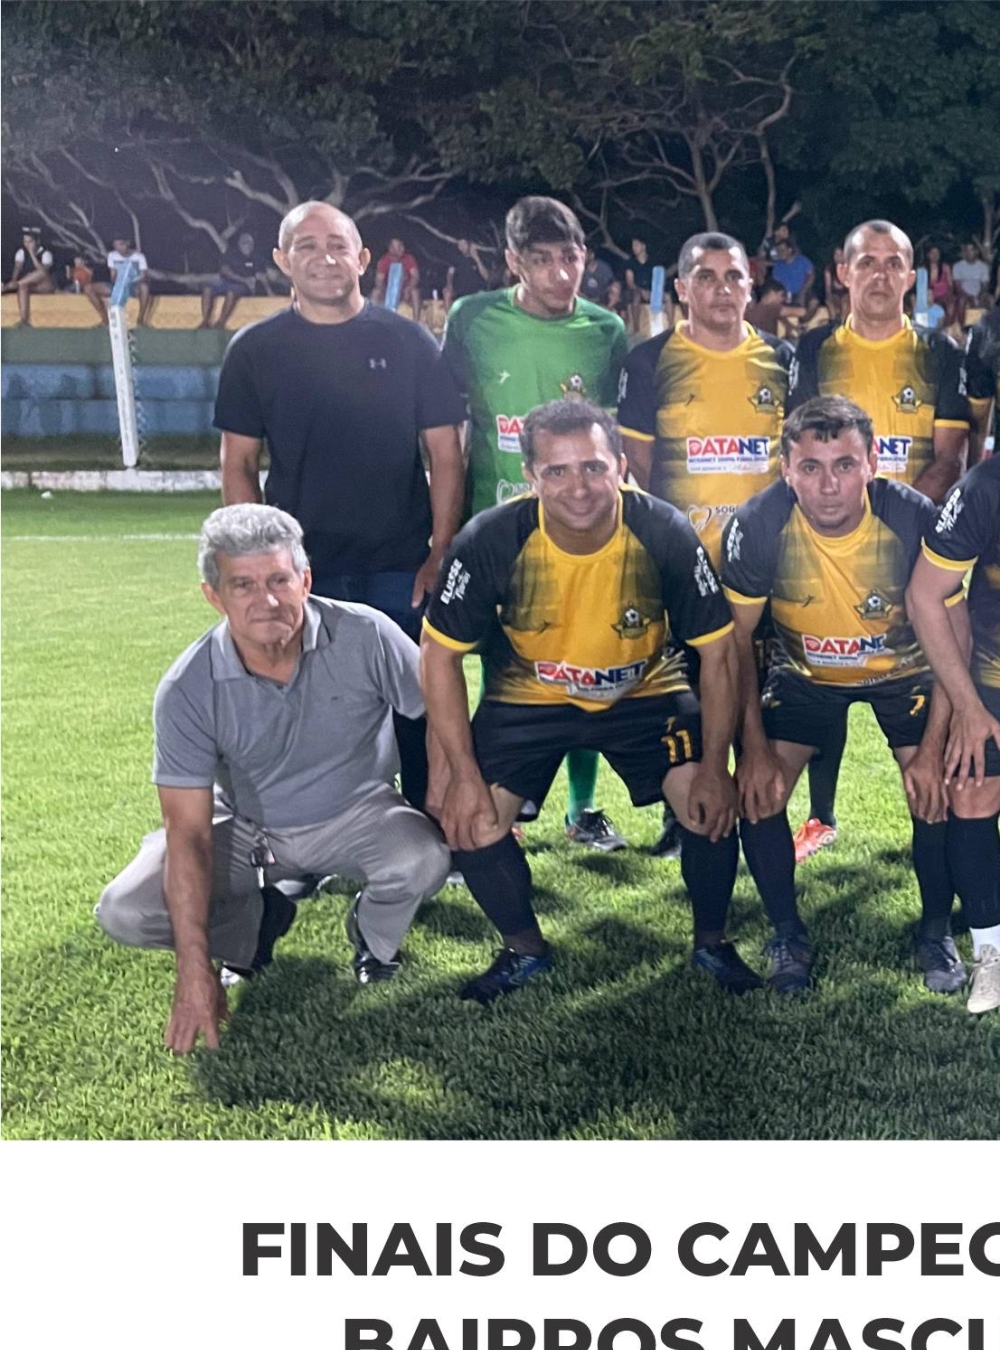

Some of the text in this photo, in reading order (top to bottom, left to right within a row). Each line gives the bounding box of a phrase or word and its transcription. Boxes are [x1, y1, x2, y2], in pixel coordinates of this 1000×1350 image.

[688, 437, 769, 457] DATANET
[537, 659, 646, 686] DATANET
[661, 729, 693, 763] 11
